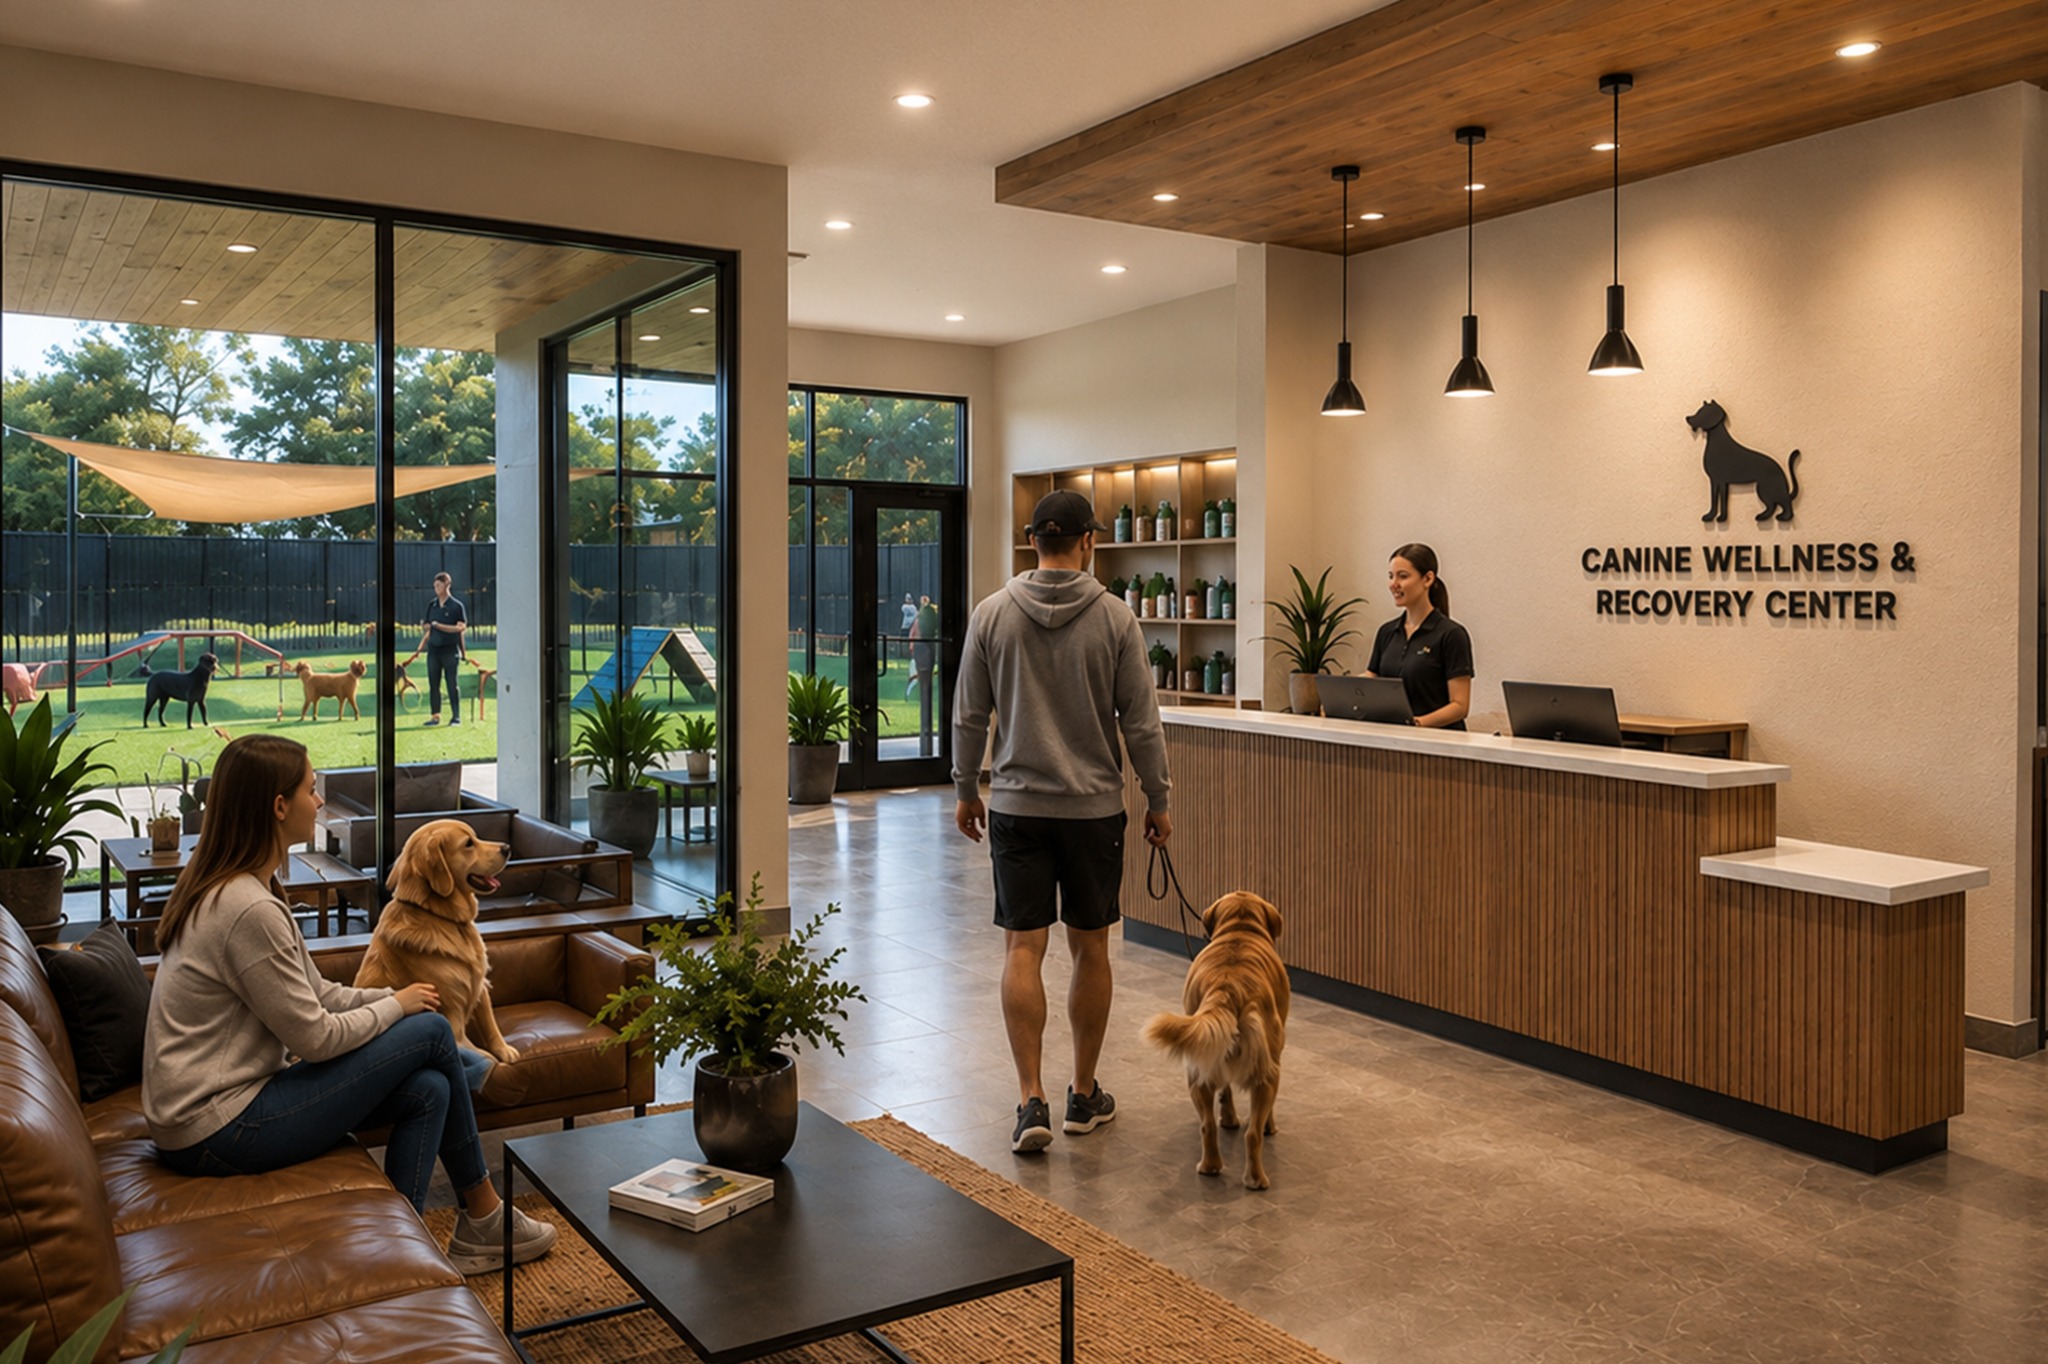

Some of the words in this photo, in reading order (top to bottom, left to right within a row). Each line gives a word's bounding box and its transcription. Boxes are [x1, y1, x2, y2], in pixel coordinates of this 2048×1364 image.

[1581, 546, 1692, 574] CANINE
[1702, 542, 1879, 573] WELLNESS
[1890, 541, 1916, 573] &
[1596, 589, 1754, 618] RECOVERY
[1765, 590, 1897, 621] CENTER
